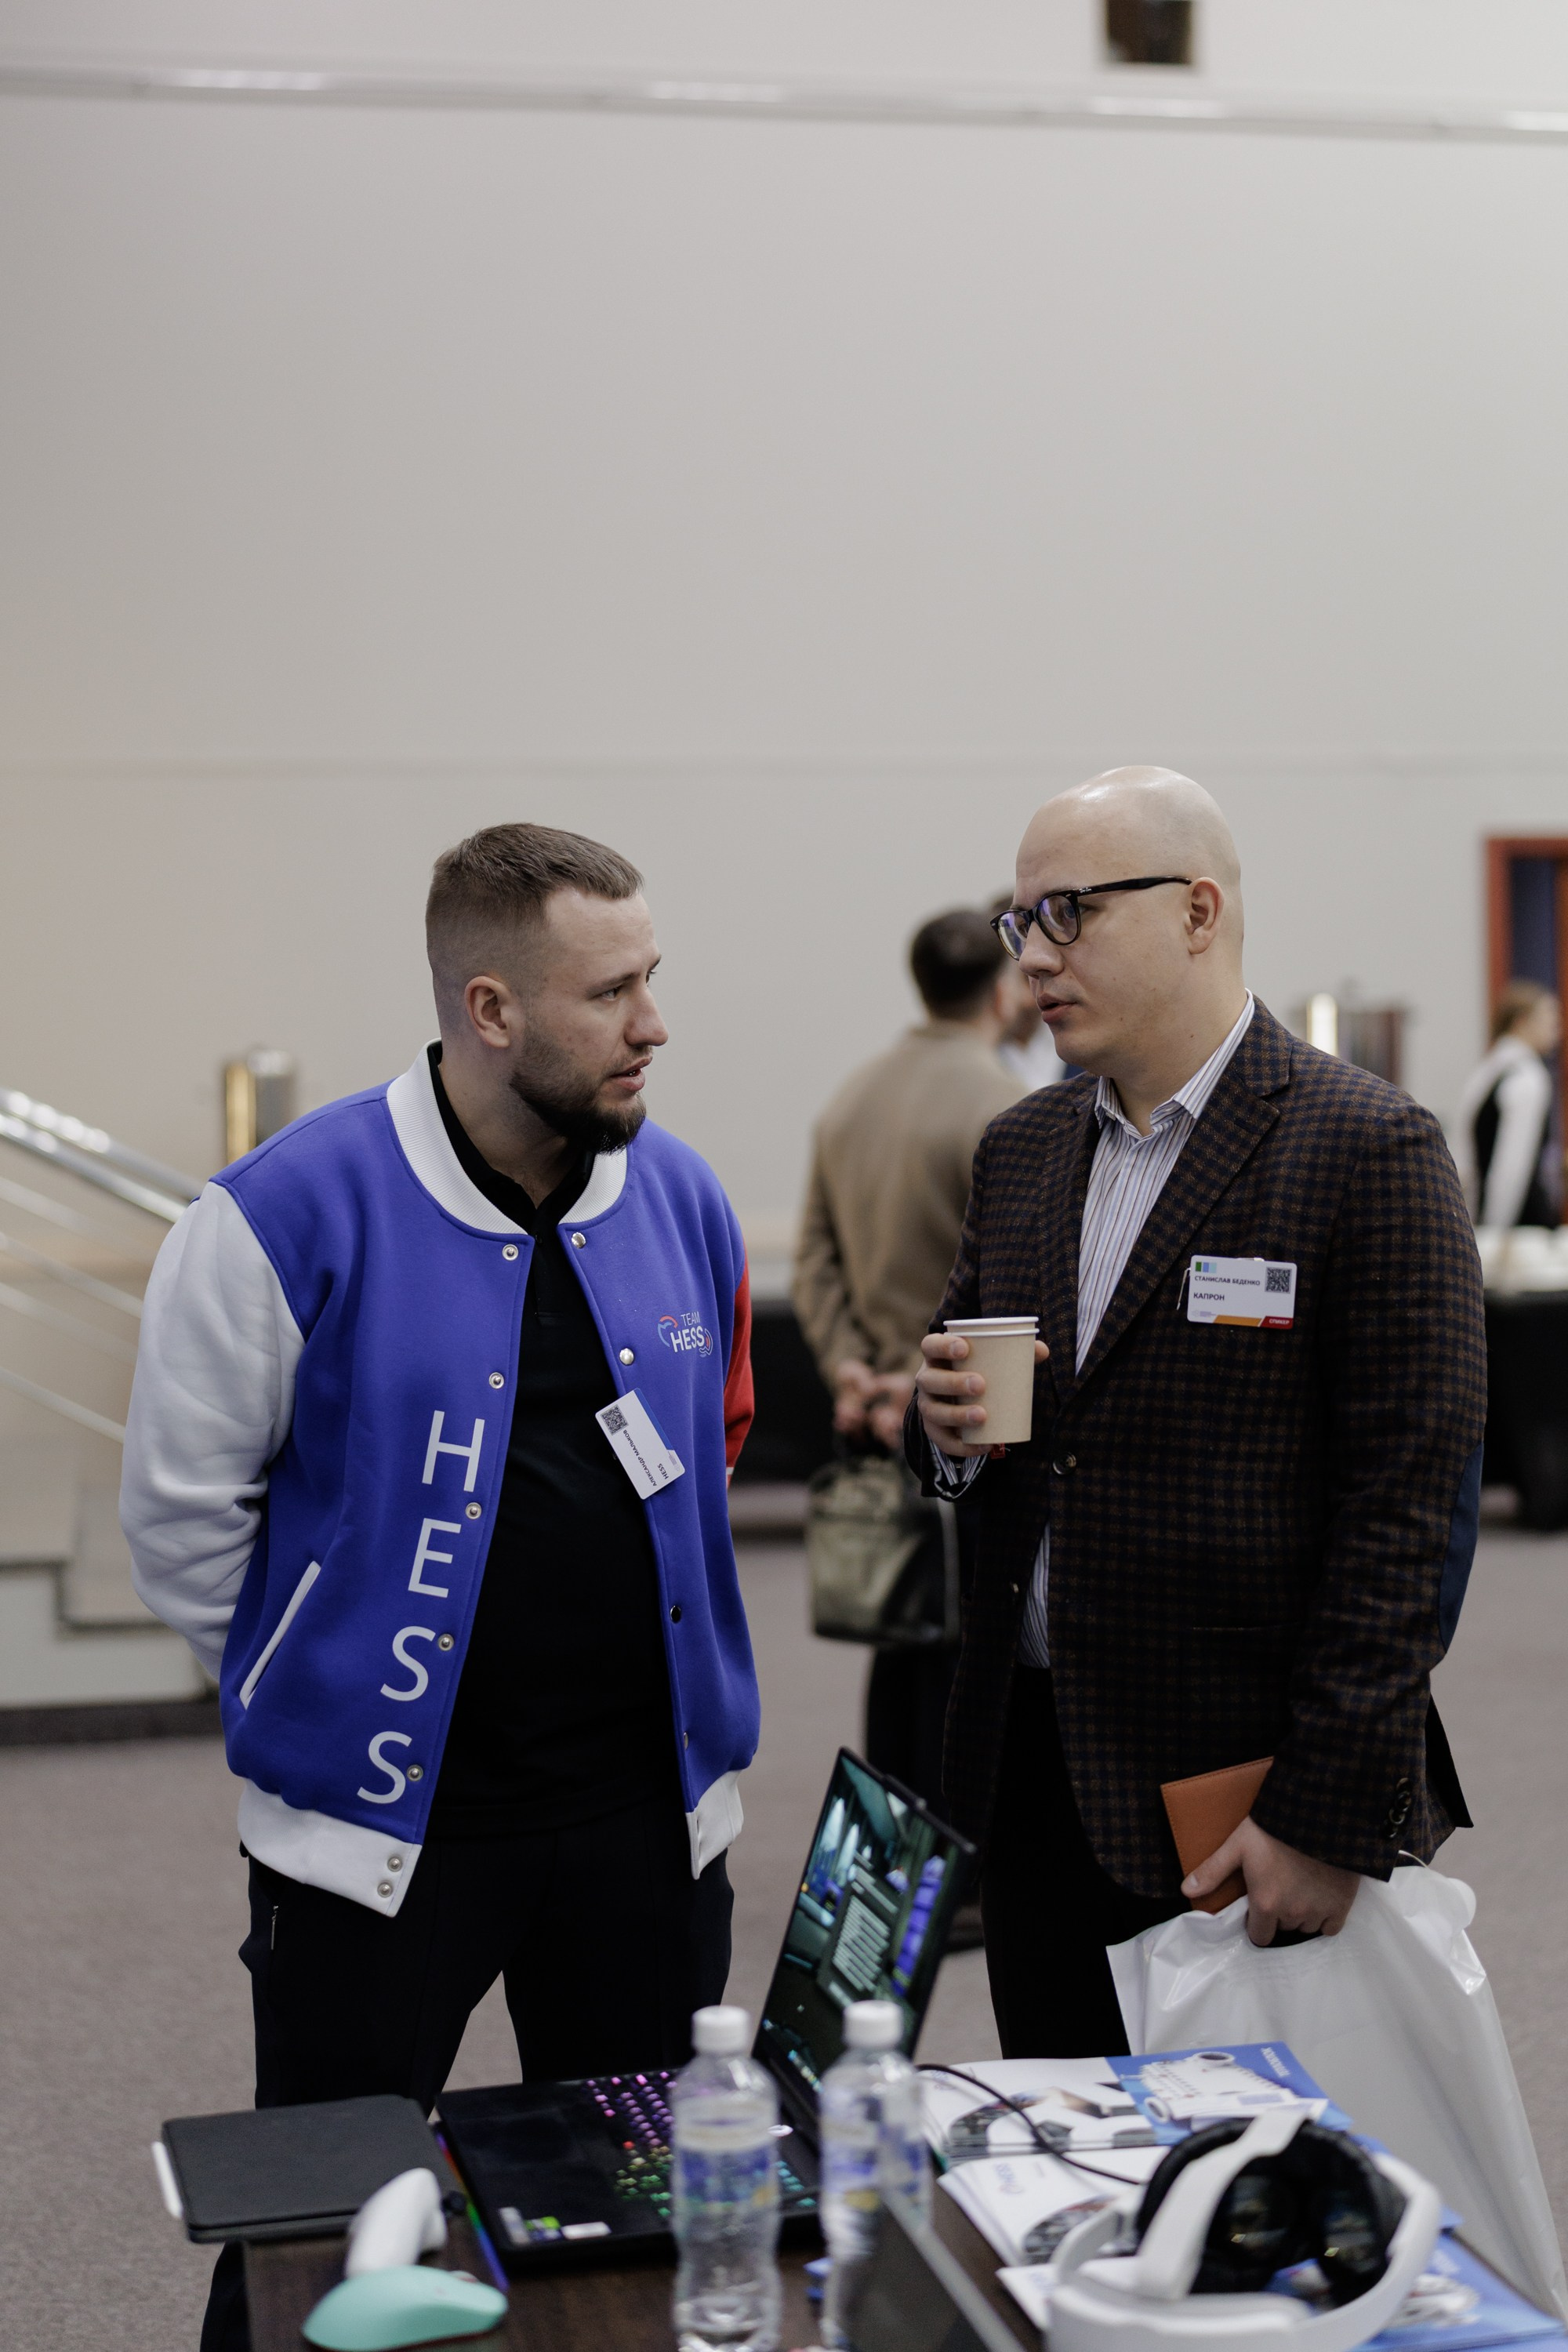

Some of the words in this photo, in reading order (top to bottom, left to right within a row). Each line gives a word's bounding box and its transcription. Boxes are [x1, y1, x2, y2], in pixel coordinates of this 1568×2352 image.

[1194, 1275, 1231, 1283] СТАНИСЛАВ
[1193, 1292, 1225, 1301] КАПРОН
[681, 1311, 701, 1327] TEAM
[670, 1325, 705, 1352] HESS
[622, 1429, 640, 1457] МАЛЬКОВ
[637, 1456, 657, 1486] АЛЕКСАНДР
[657, 1463, 669, 1479] HESS
[357, 1410, 485, 1805] HESS
